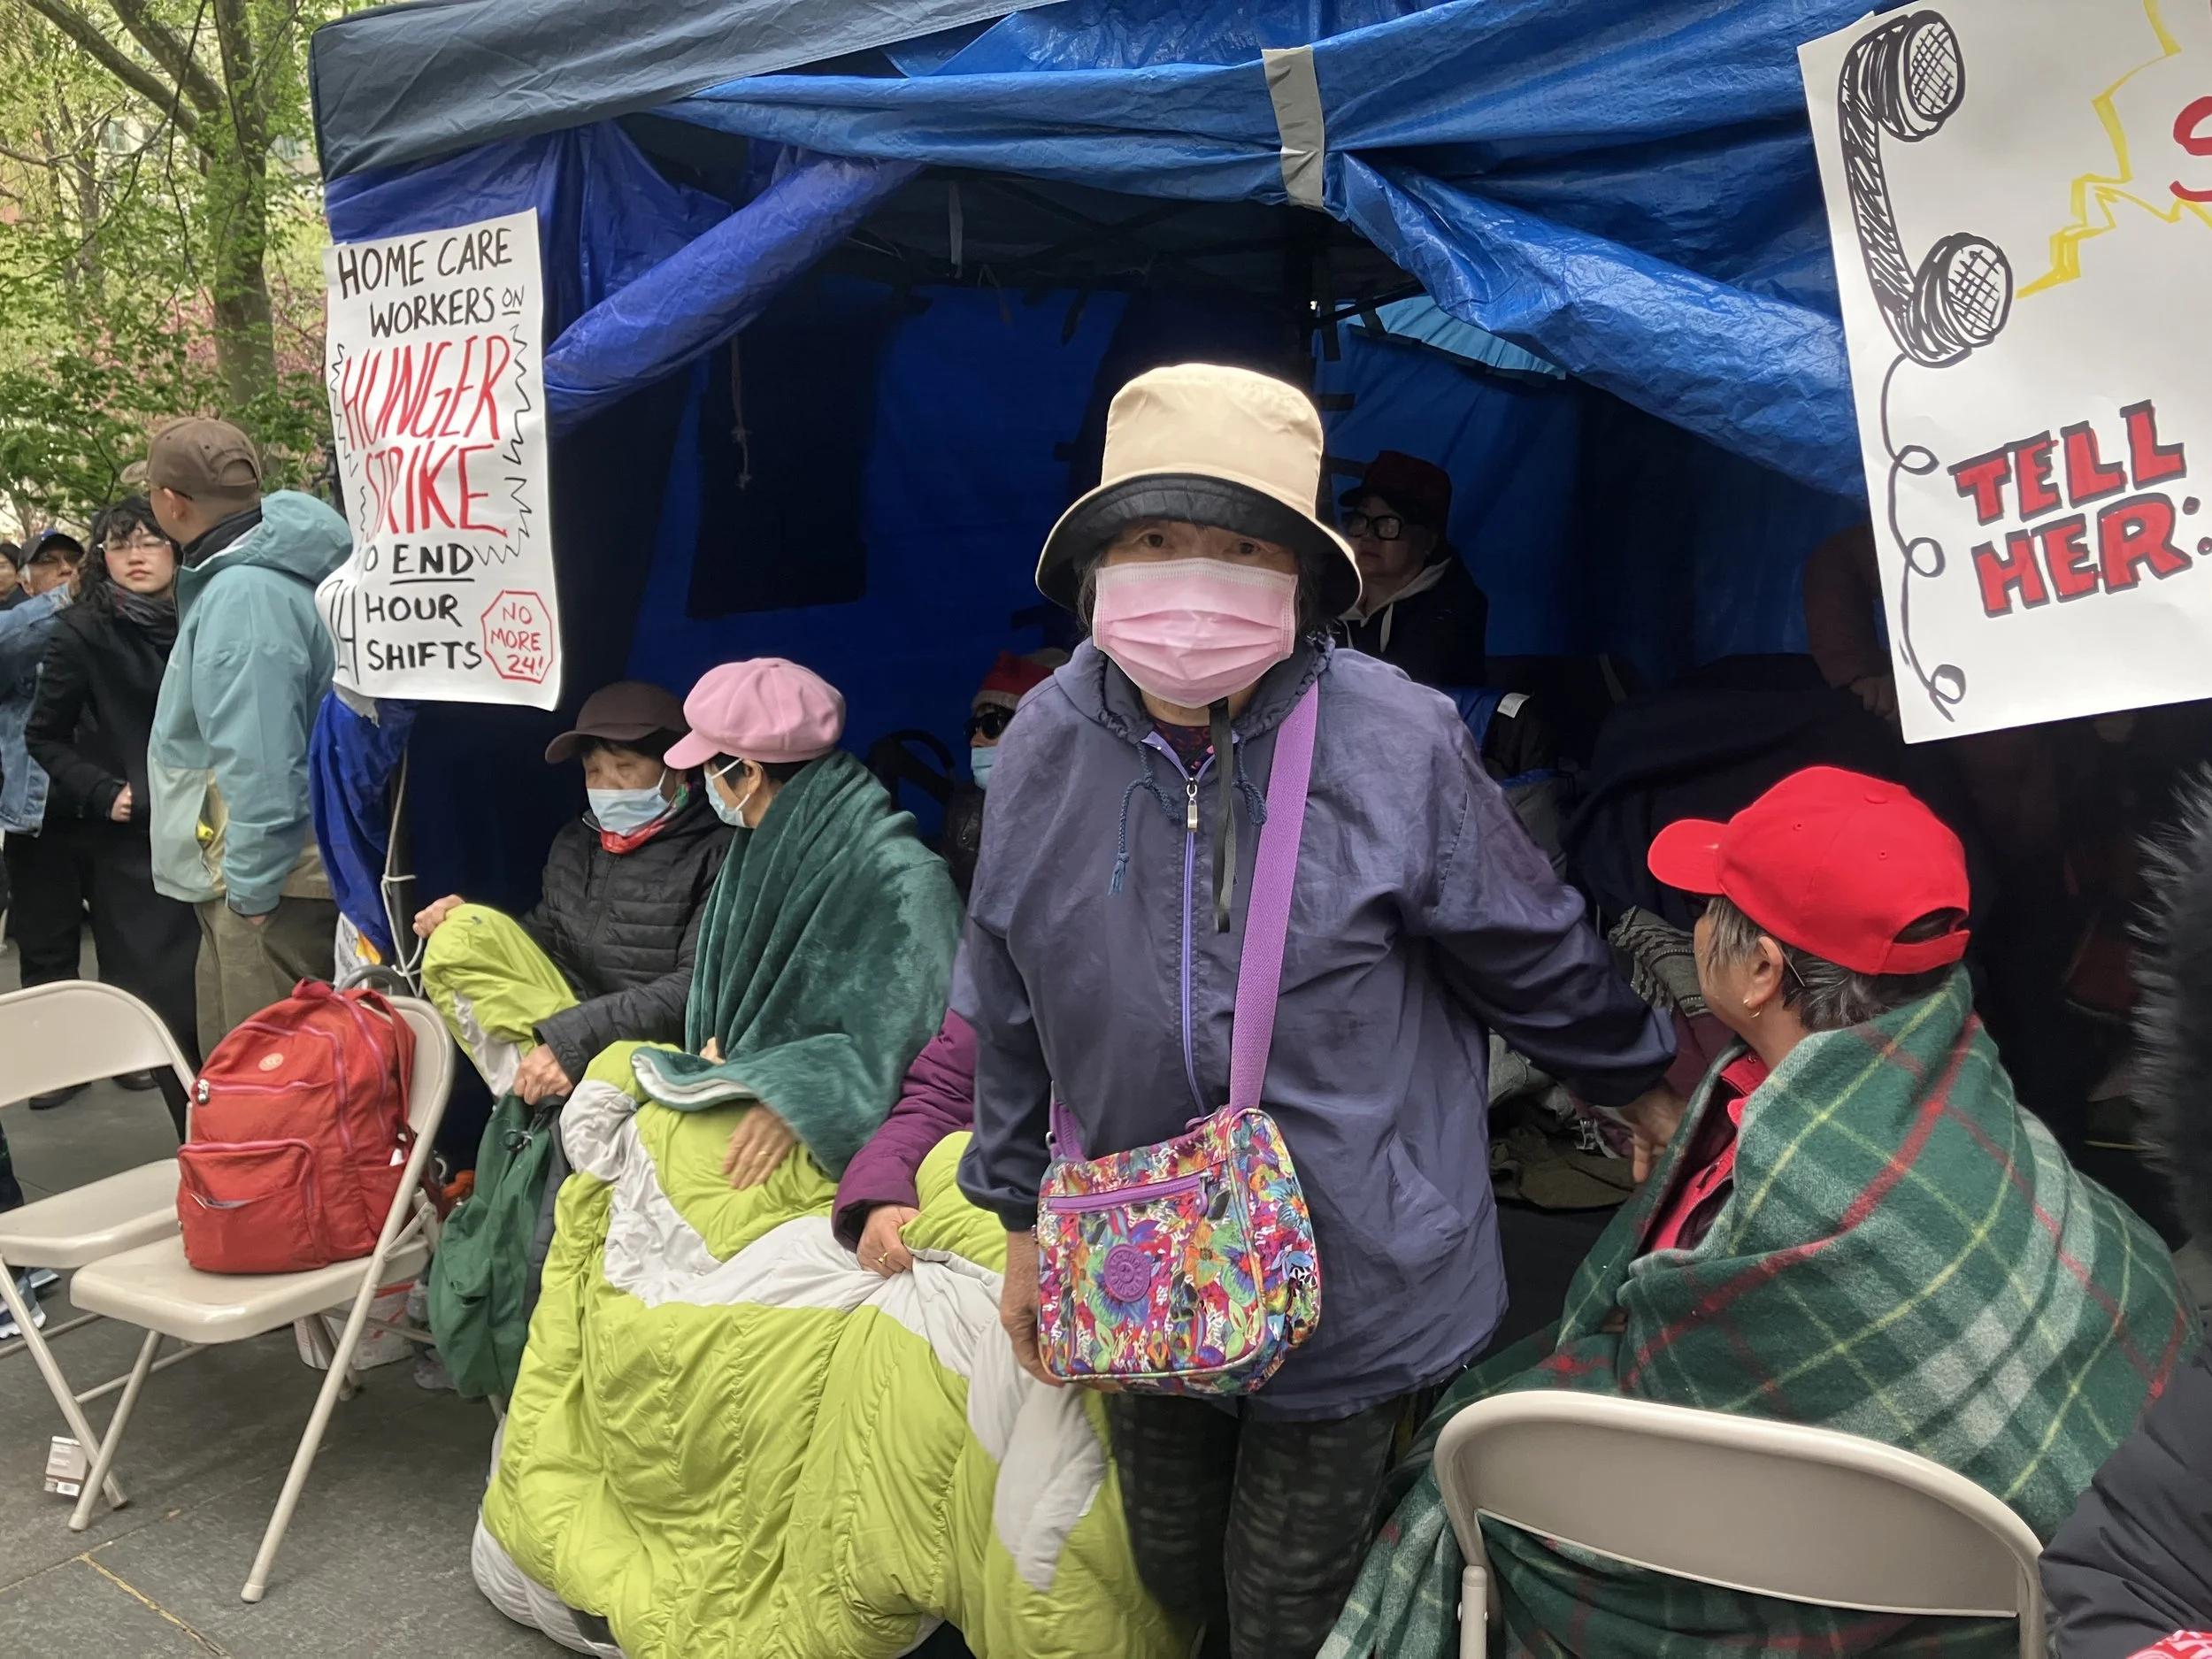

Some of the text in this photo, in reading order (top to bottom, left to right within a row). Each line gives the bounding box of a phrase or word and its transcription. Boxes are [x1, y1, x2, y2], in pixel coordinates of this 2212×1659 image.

[337, 227, 512, 299] HOME CARE
[370, 285, 524, 338] WORKERS ON
[341, 334, 511, 451] HUNGER
[1947, 399, 2187, 526] TELL
[365, 441, 508, 543] STRIKE
[392, 543, 473, 576] END
[365, 592, 463, 627] HOUR
[503, 603, 533, 625] NO
[366, 640, 482, 671] SHIFTS
[491, 628, 541, 652] MORE
[507, 655, 544, 676] 24!
